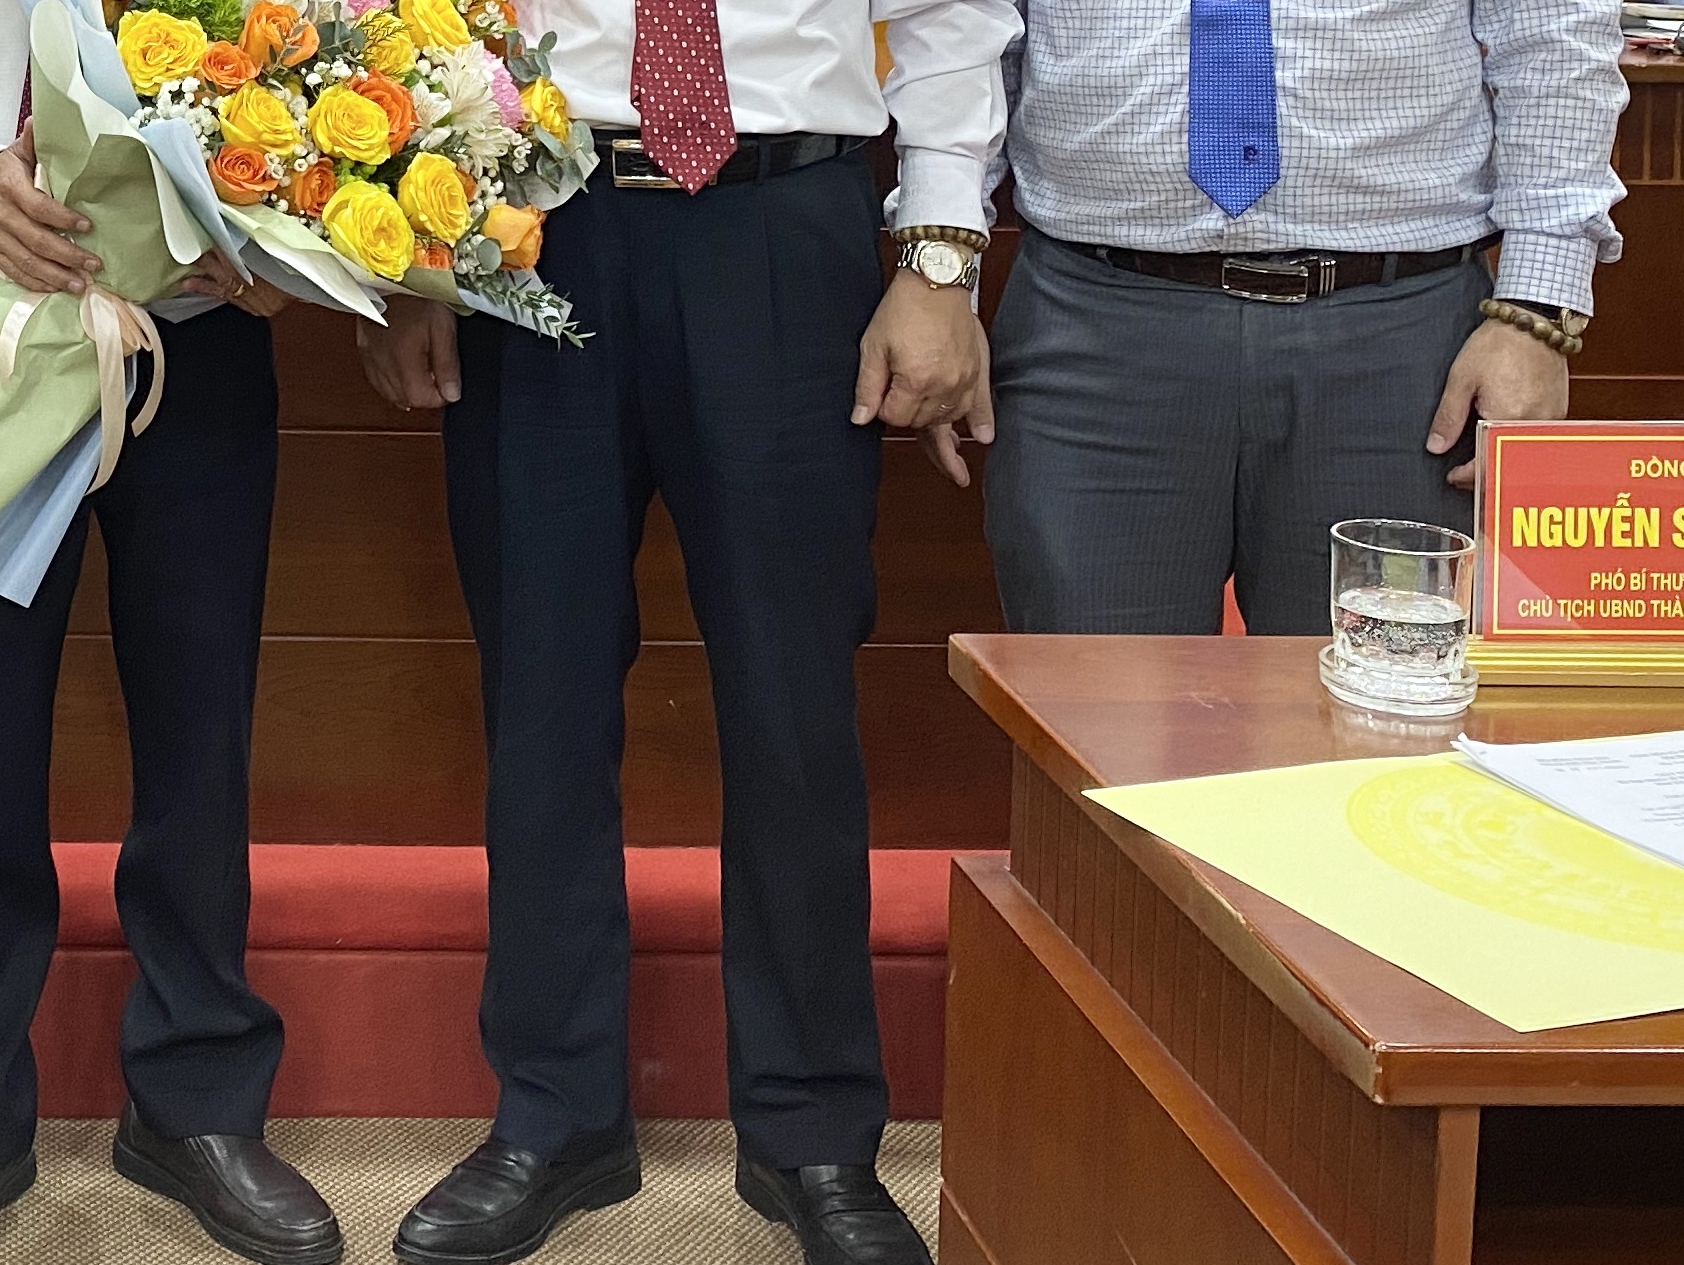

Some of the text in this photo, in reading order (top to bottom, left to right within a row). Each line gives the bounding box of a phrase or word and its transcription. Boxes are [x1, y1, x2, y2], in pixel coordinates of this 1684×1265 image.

[1630, 455, 1684, 478] ĐỒN
[1512, 492, 1660, 548] NGUYỄN
[1590, 568, 1626, 591] PHÓ
[1630, 568, 1647, 591] BÍ
[1518, 595, 1553, 618] CHỦ
[1557, 599, 1595, 622] TỊCH
[1600, 599, 1646, 618] UBND
